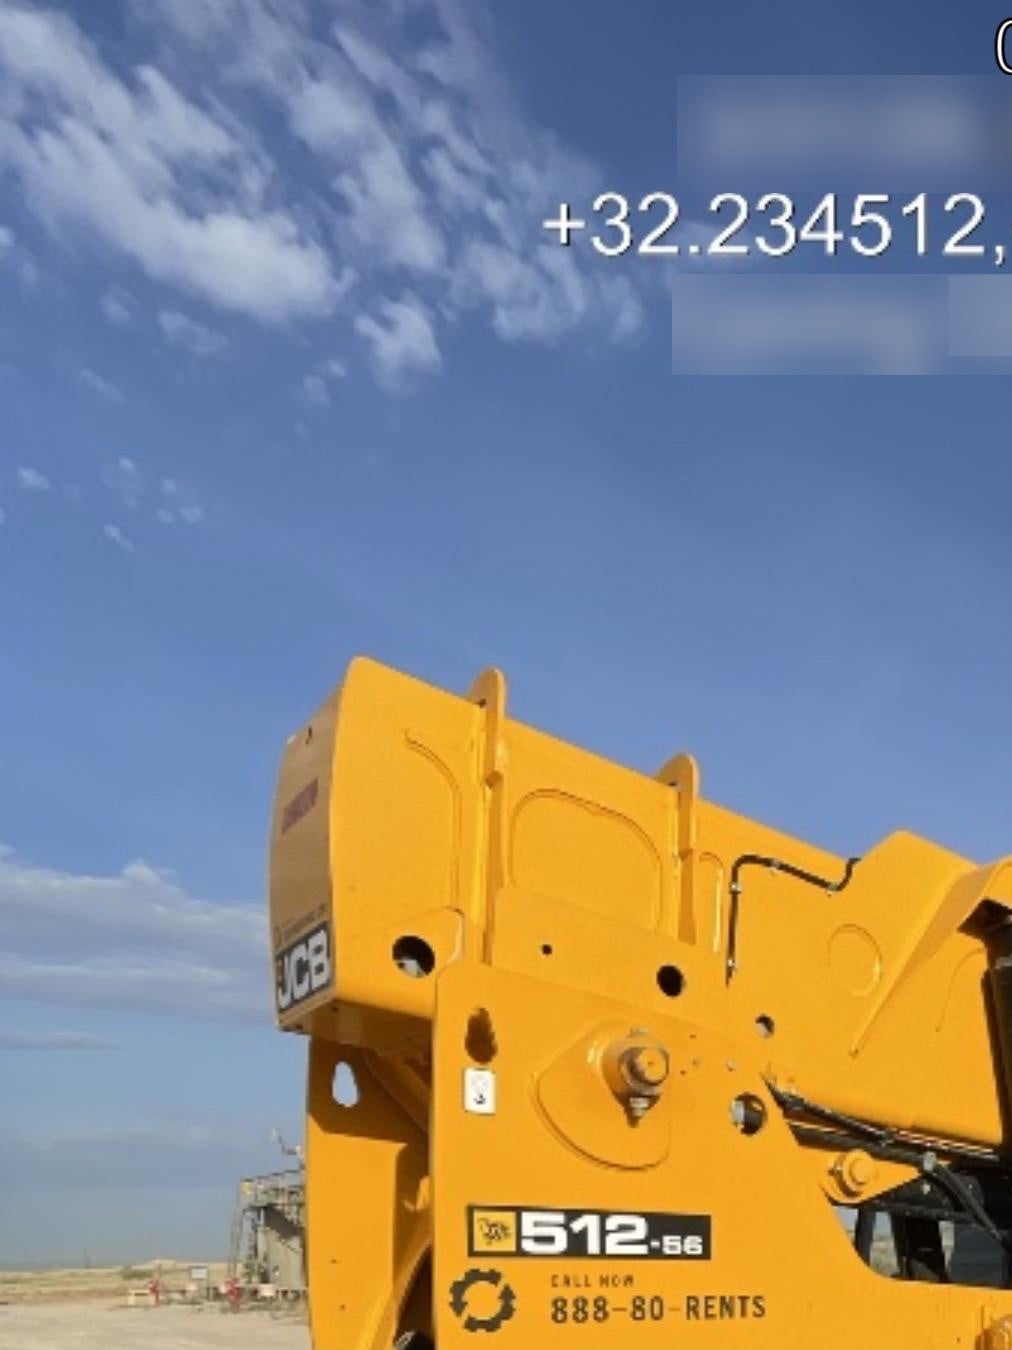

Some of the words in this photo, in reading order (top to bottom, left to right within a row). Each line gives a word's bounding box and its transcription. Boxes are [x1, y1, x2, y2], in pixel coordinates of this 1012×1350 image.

[278, 929, 331, 1009] JCB
[520, 1210, 704, 1256] 512-56
[550, 1274, 592, 1288] CALL
[599, 1274, 635, 1288] NOW
[550, 1295, 767, 1324] 888-80-RENTS
